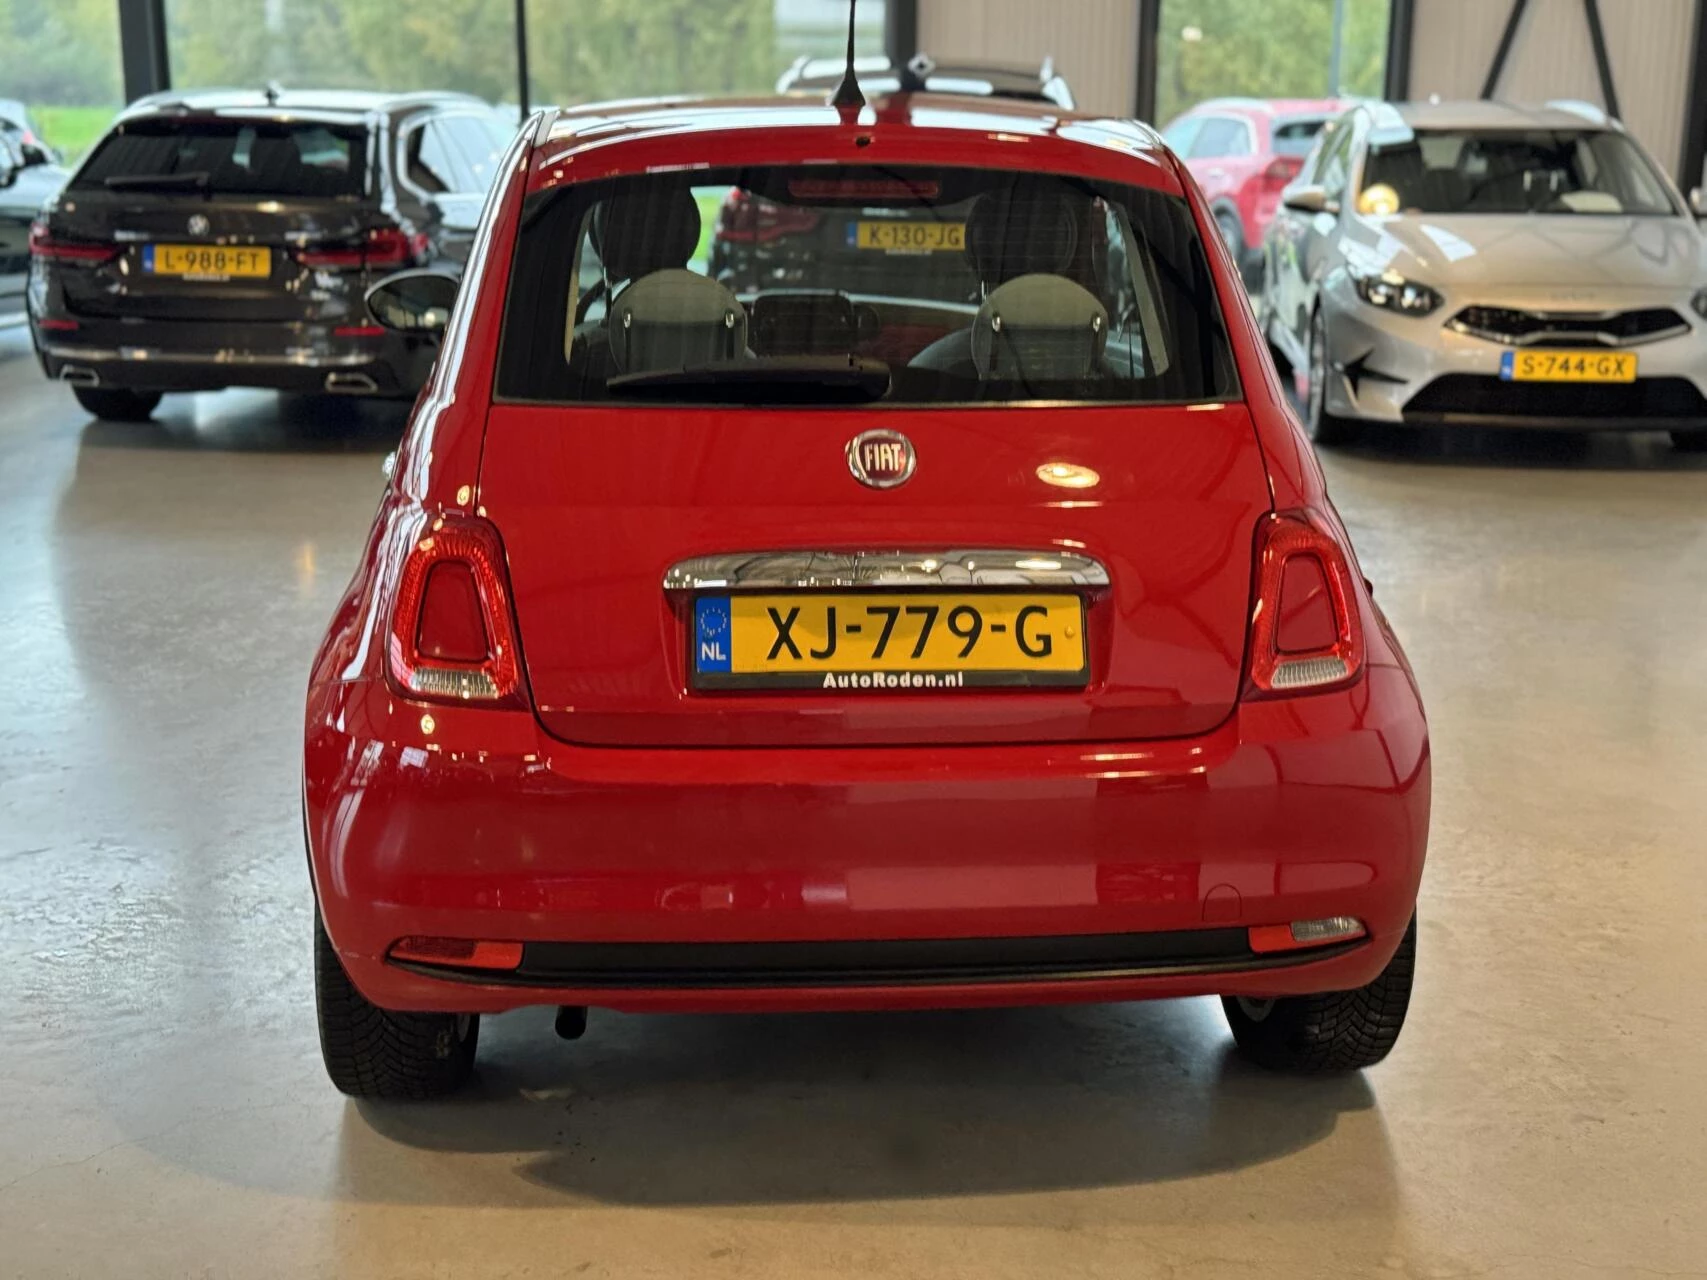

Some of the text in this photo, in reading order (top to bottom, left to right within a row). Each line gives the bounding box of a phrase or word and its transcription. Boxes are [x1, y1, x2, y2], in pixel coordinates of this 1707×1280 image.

[165, 250, 259, 271] L-988-FT
[1522, 355, 1626, 375] S-744-GX
[864, 443, 902, 471] FIAT
[766, 605, 1053, 661] XJ-779-G
[701, 642, 727, 661] NL
[823, 671, 964, 689] AutoRoden.nl
